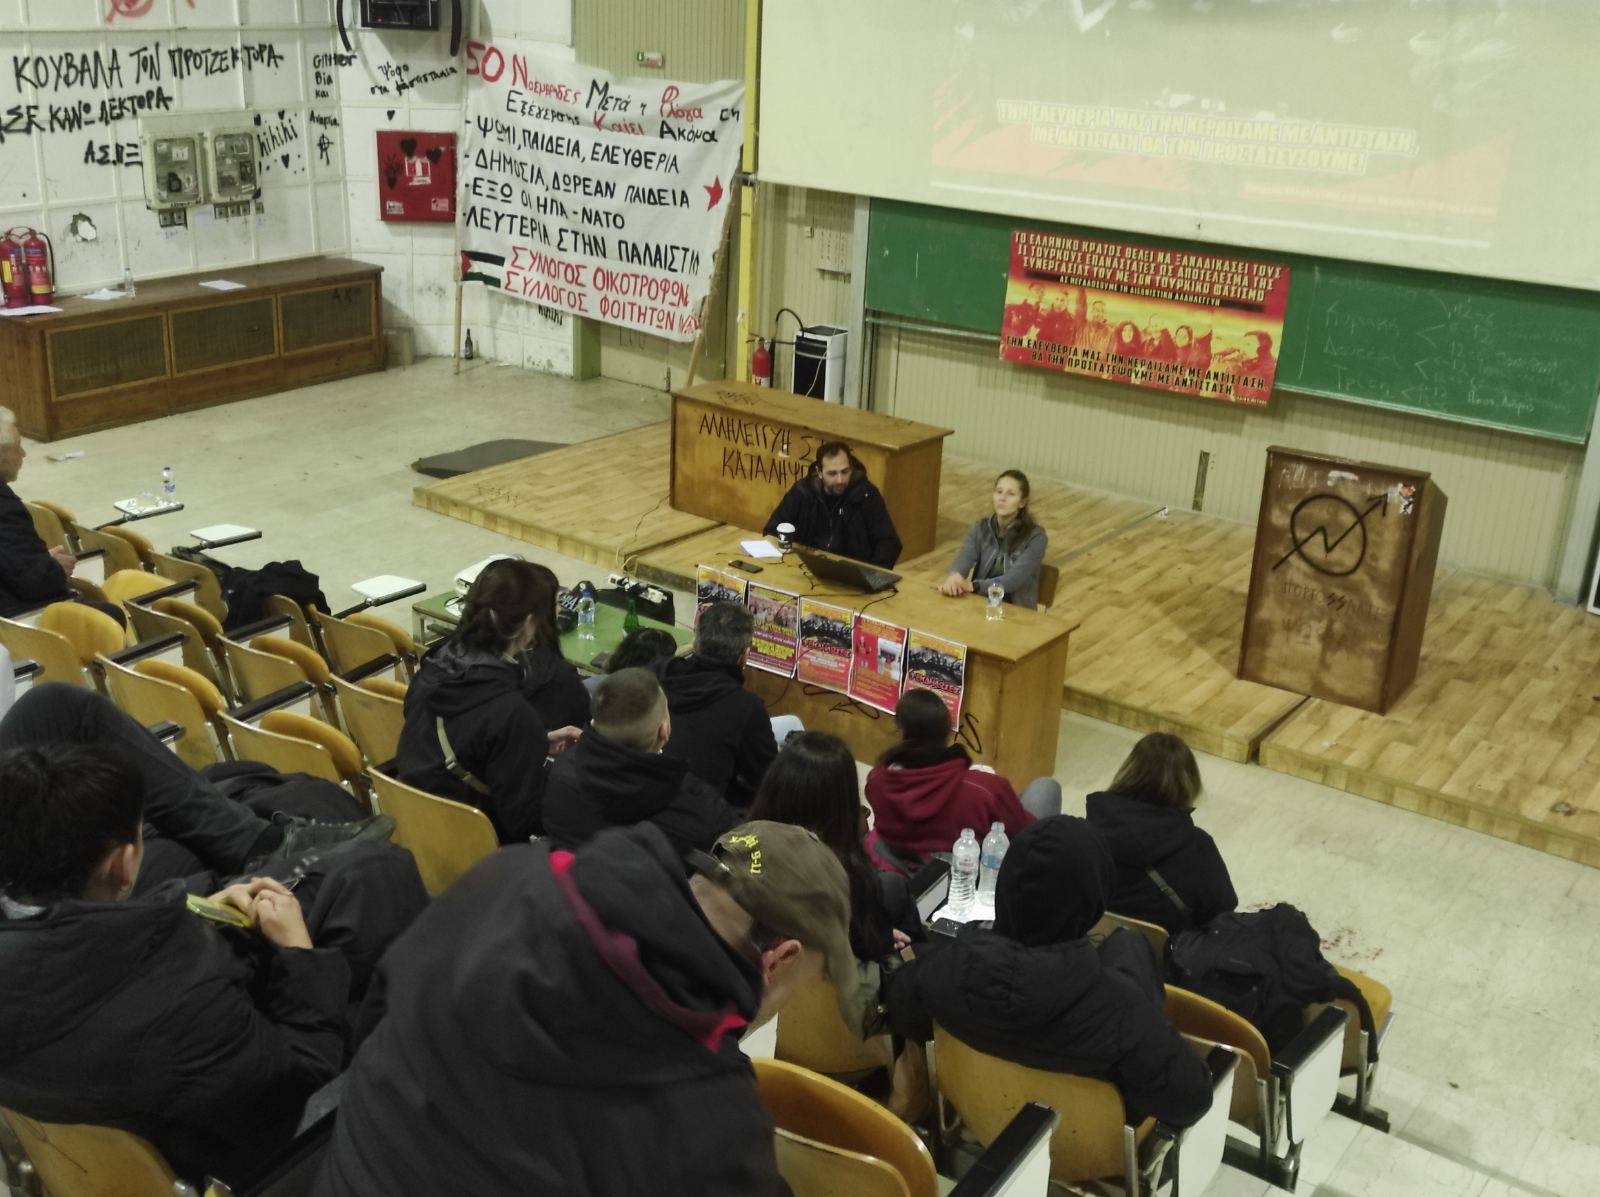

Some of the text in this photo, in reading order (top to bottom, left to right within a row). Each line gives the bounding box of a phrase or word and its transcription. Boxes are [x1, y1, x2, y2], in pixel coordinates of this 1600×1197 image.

[129, 41, 161, 84] ΤΟΝ
[168, 43, 284, 80] ΠΡΟΤΖΕΚΤΟΡΑ
[466, 41, 505, 82] 50
[98, 86, 173, 126] ΛΕΚΤΟΡΑ
[1000, 103, 1029, 122] ΤΗΝ
[1031, 105, 1111, 127] ΕΛΕΥΘΕΡΙΑ
[1113, 110, 1146, 129] ΜΑΣ
[1151, 114, 1184, 133] ΤΗΝ
[1186, 117, 1280, 141] ΚΕΡΔΙΣΑΜΕ
[1282, 125, 1310, 143] ΜΕ
[256, 118, 298, 157] hihihi
[591, 142, 679, 174] ΕΛΕΥΘΕΡΙΑ
[1033, 126, 1056, 145] ΜΕ
[1057, 128, 1138, 151] ΑΝΤΙΣΤΑΣΗ
[1141, 136, 1164, 154] ΘΑ
[1166, 138, 1199, 157] ΤΗΝ
[472, 178, 513, 204] ΕΞΩ
[521, 192, 532, 208] ΟΙ
[552, 171, 616, 199] ΔΩΡΕΑΝ
[625, 185, 690, 208] ΠΑΙΔΕΙΑ
[465, 206, 550, 245] ΛΕΥΤΕΡΙΑ
[557, 228, 607, 259] ΣΤΗΝ
[1014, 232, 1282, 279] ΤΟ ΕΛΛΗΝΙΚΟ ΚΡΑΤΟΣ ΘΕΛΕΙ ΝΑ ΞΑΝΑΔΙΚΑΣΕΙ ΤΟΥΣ
[1031, 246, 1082, 263] ΤΟΥΡΚΟΥΣ
[1086, 253, 1156, 275] ΕΠΑΝΑΣΤΑΤΕΣ
[1159, 263, 1174, 276] ΩΣ
[1177, 265, 1249, 287] ΑΠΟΤΕΛΕΣΜΑ
[1253, 276, 1274, 290] ΤΗΣ
[510, 246, 690, 308] ΣΥΛΛΟΓΟΣ ΟΙΚΟΤΡΟΦΩΝ
[1023, 257, 1265, 302] ΣΥΝΕΡΓΑΣΙΑΣ ΤΟΥ ΜΕ ΤΟΝ ΤΟΥΡΚΙΚΟ ΦΑΣΙΣΜΟ
[504, 271, 588, 313] ΣΥΛΛΟΓΟΣ
[599, 295, 675, 331] ΦΟΙΤΗΤΩΝ
[1005, 335, 1023, 346] ΤΗΝ
[1027, 339, 1078, 357] ΕΛΕΥΘΕΡΙΑ
[1082, 349, 1101, 361] ΜΑΣ
[1106, 353, 1124, 365] ΤΗΝ
[1127, 357, 1184, 376] ΚΕΡΔΙΣΑΜΕ
[1187, 367, 1202, 378] ΜΕ
[1031, 351, 1043, 361] ΘΑ
[1047, 353, 1065, 365] ΤΗΝ
[1067, 356, 1153, 382] ΠΡΟΣΤΑΤΕΨΟΥΜΕ
[1157, 373, 1173, 385] ΜΕ
[698, 412, 791, 455] ΑΛΛΗΛΕΓΓΥΗ
